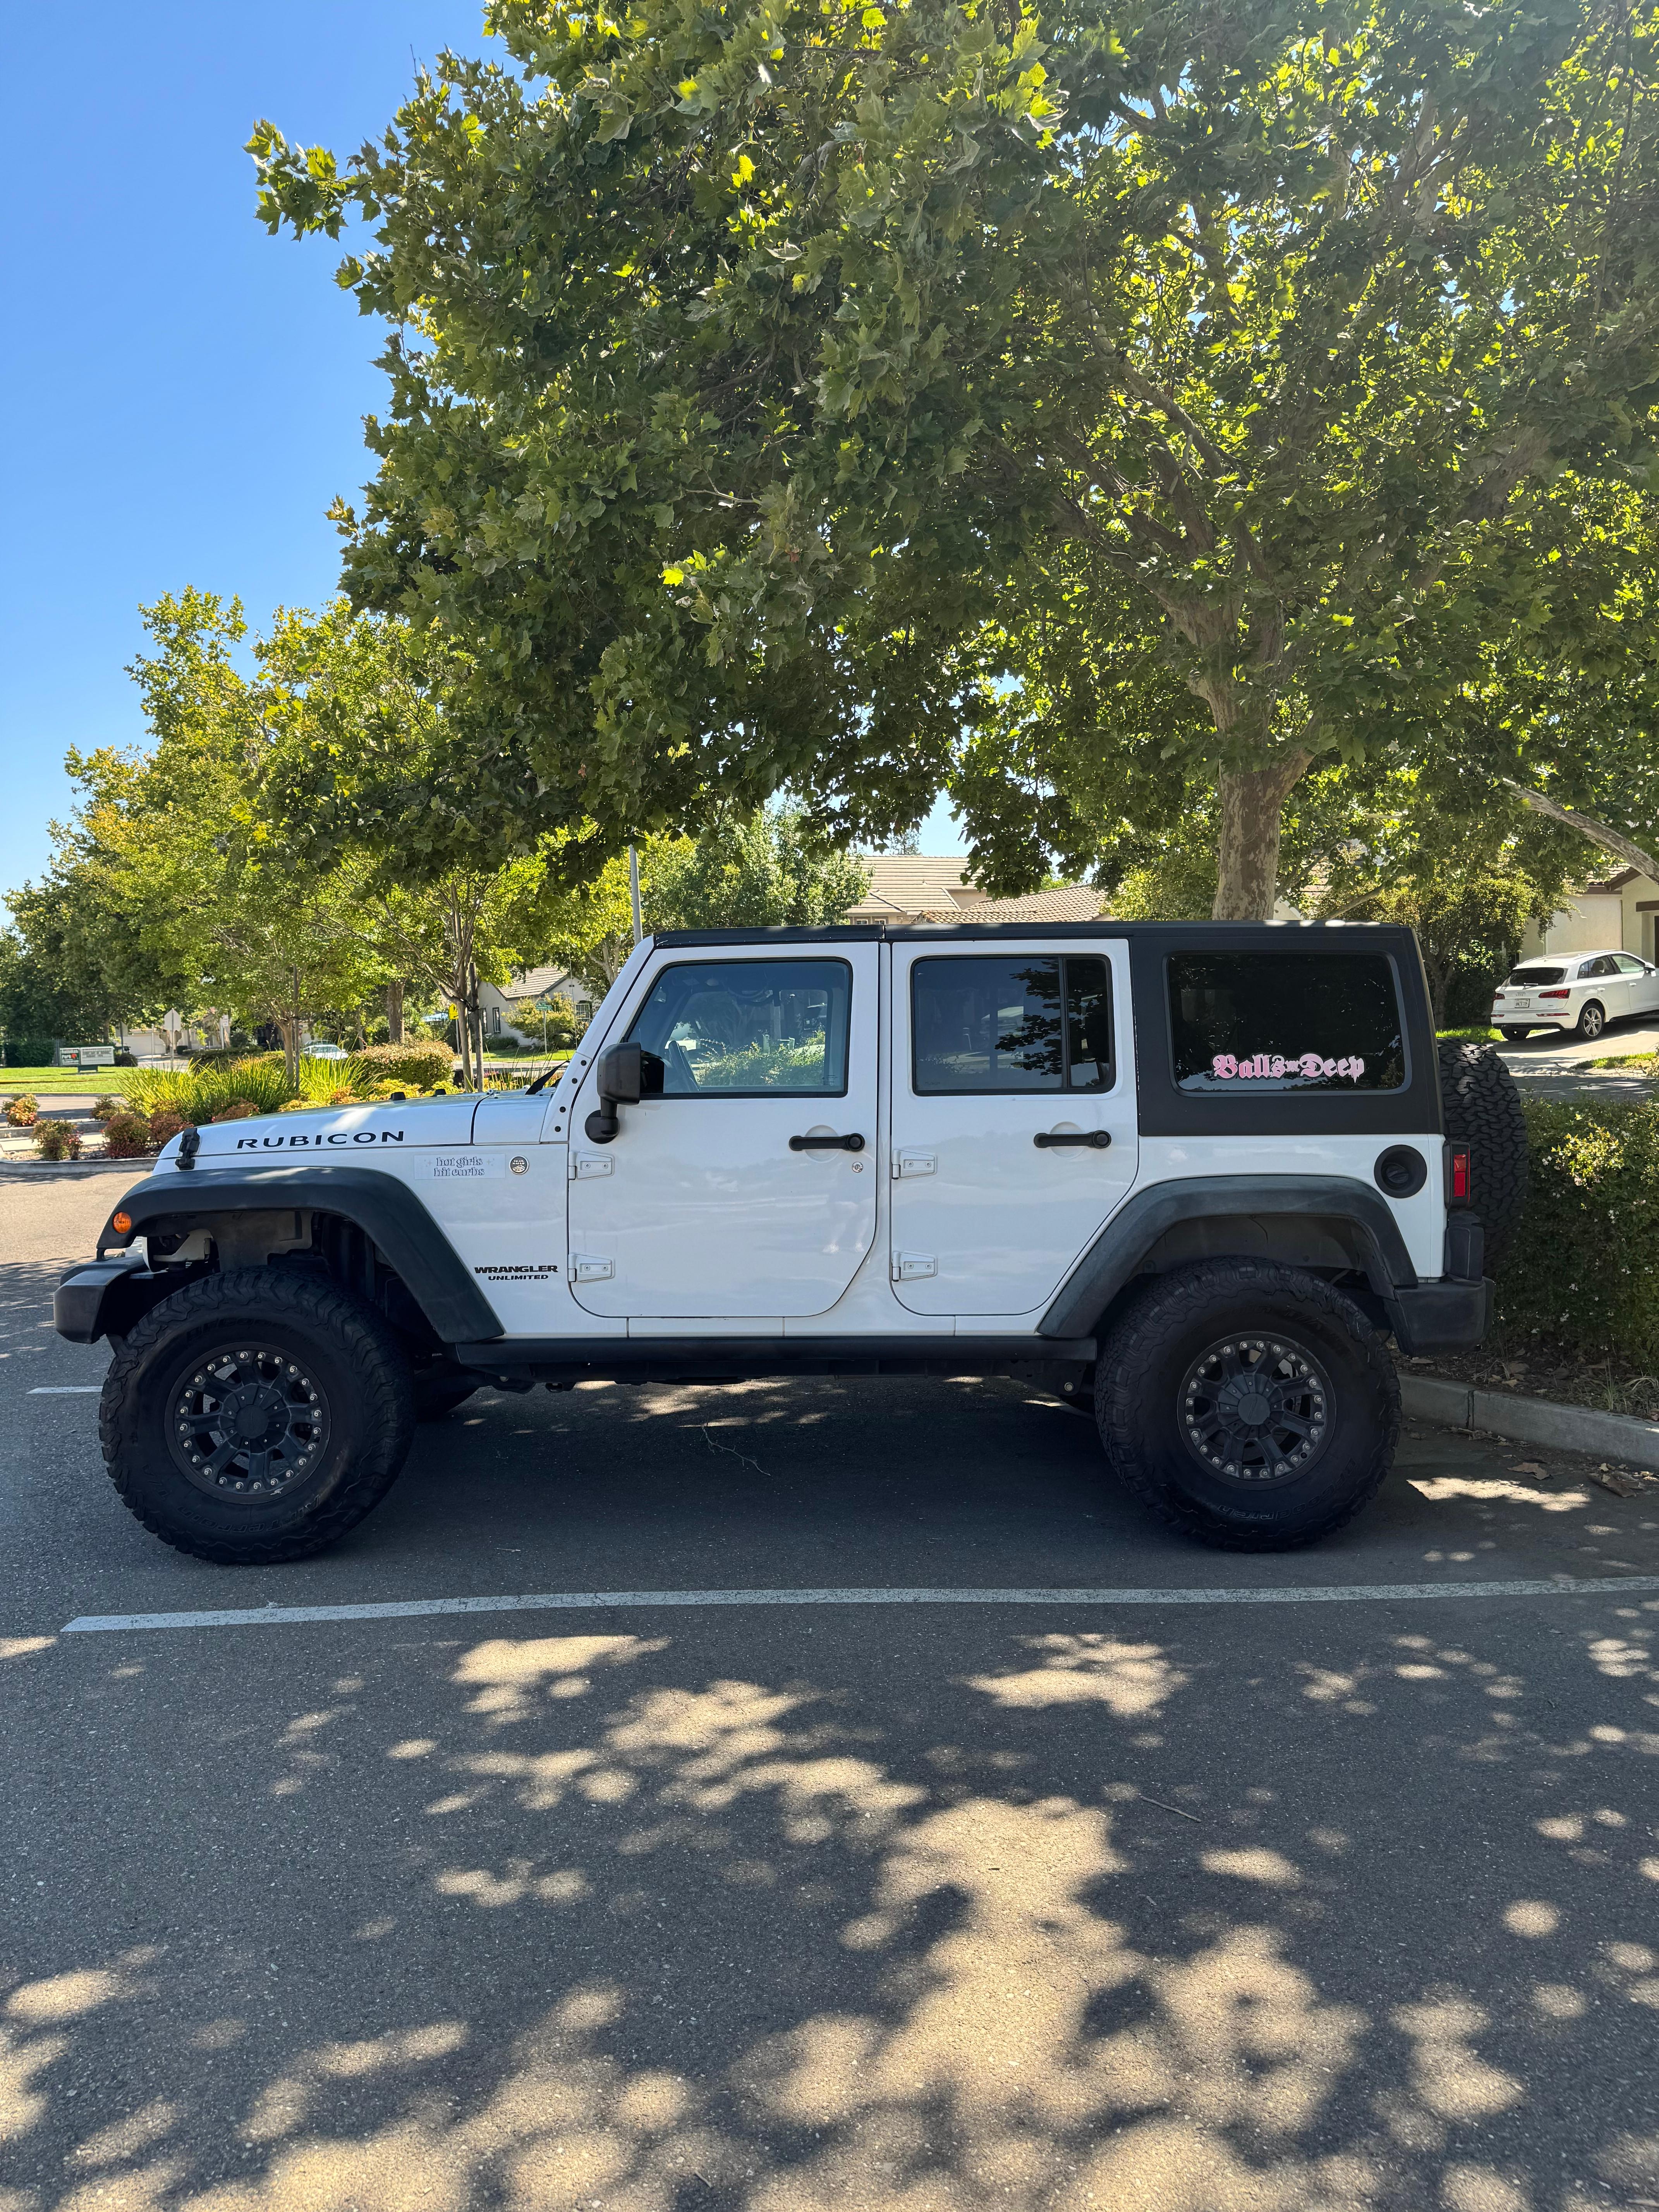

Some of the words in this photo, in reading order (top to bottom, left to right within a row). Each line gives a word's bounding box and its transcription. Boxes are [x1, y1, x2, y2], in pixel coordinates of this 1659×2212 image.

[237, 1131, 404, 1149] RUBICON
[436, 1157, 455, 1166] hot
[456, 1156, 483, 1168] girls
[434, 1167, 450, 1176] hit
[452, 1167, 485, 1176] curbs
[474, 1265, 559, 1274] WRANGLER
